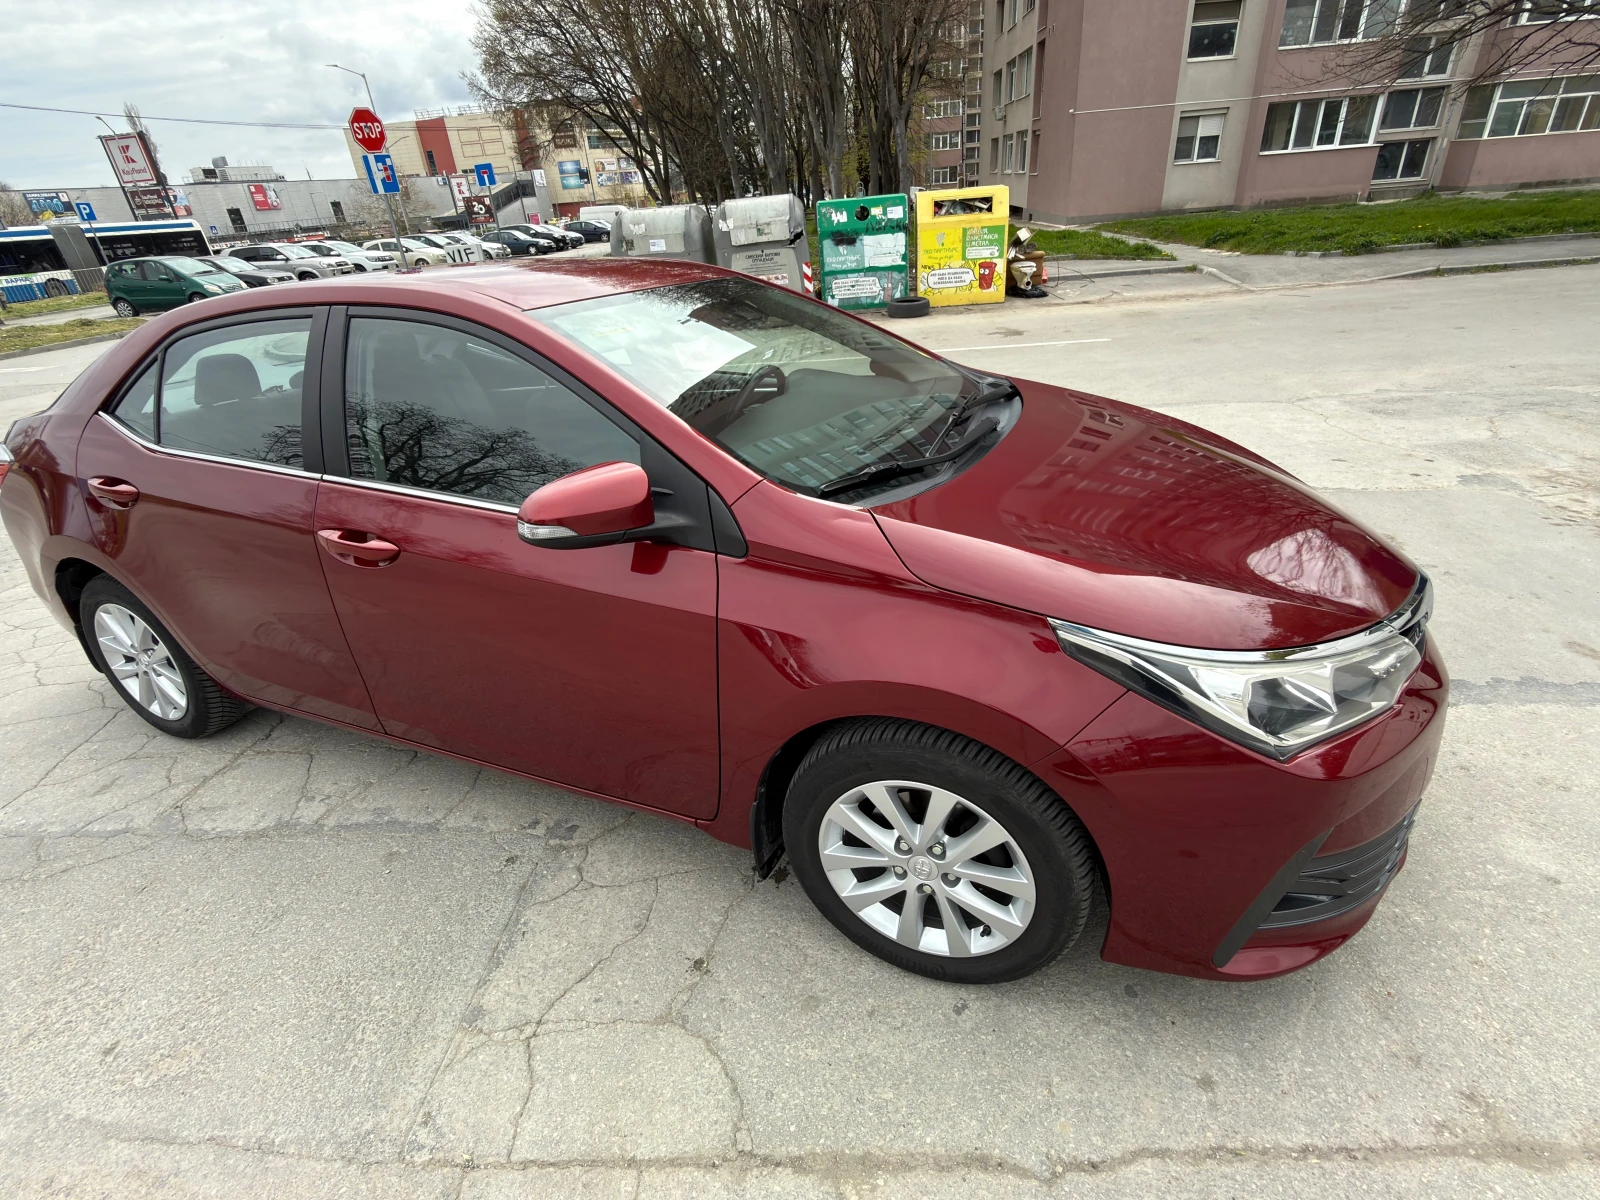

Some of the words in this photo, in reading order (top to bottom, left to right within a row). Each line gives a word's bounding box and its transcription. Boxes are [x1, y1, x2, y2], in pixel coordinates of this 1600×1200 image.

[353, 122, 382, 139] STOP
[79, 203, 91, 220] P
[472, 201, 486, 214] 20
